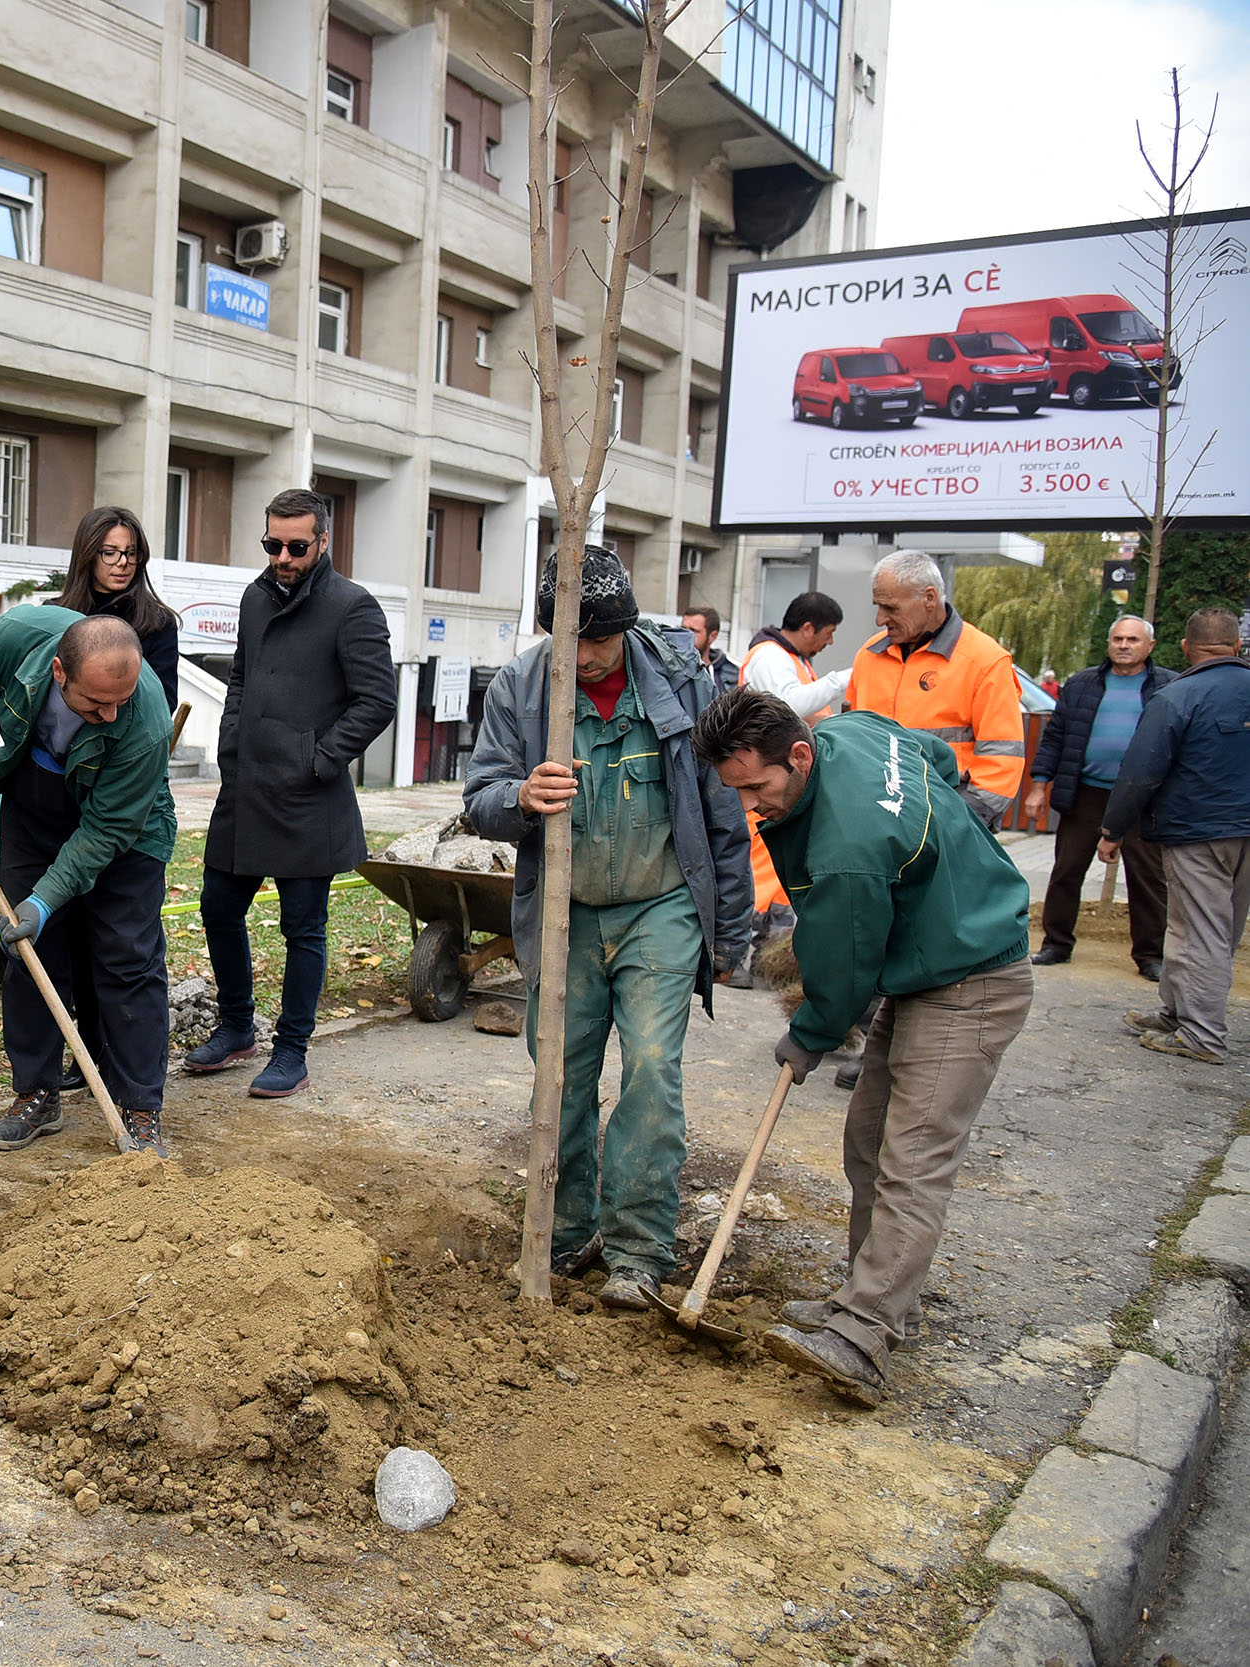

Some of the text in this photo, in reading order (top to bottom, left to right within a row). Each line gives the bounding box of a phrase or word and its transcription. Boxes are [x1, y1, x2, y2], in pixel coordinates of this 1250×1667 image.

[1196, 266, 1250, 279] CITROË
[223, 287, 266, 318] ЧАКАР
[751, 277, 904, 313] МАЈСТОРИ
[913, 273, 953, 298] ЗА
[829, 436, 1124, 460] CITROËN КОМЕРЦИЈАЛНИ ВОЗИЛА
[926, 465, 981, 475] КРЕДИТ СО
[1019, 462, 1081, 472] ПОПУСТ ДО
[833, 476, 980, 498] 0% УЧЕСТВО
[1019, 473, 1111, 493] 3.500 €
[198, 620, 237, 635] HERMOSA
